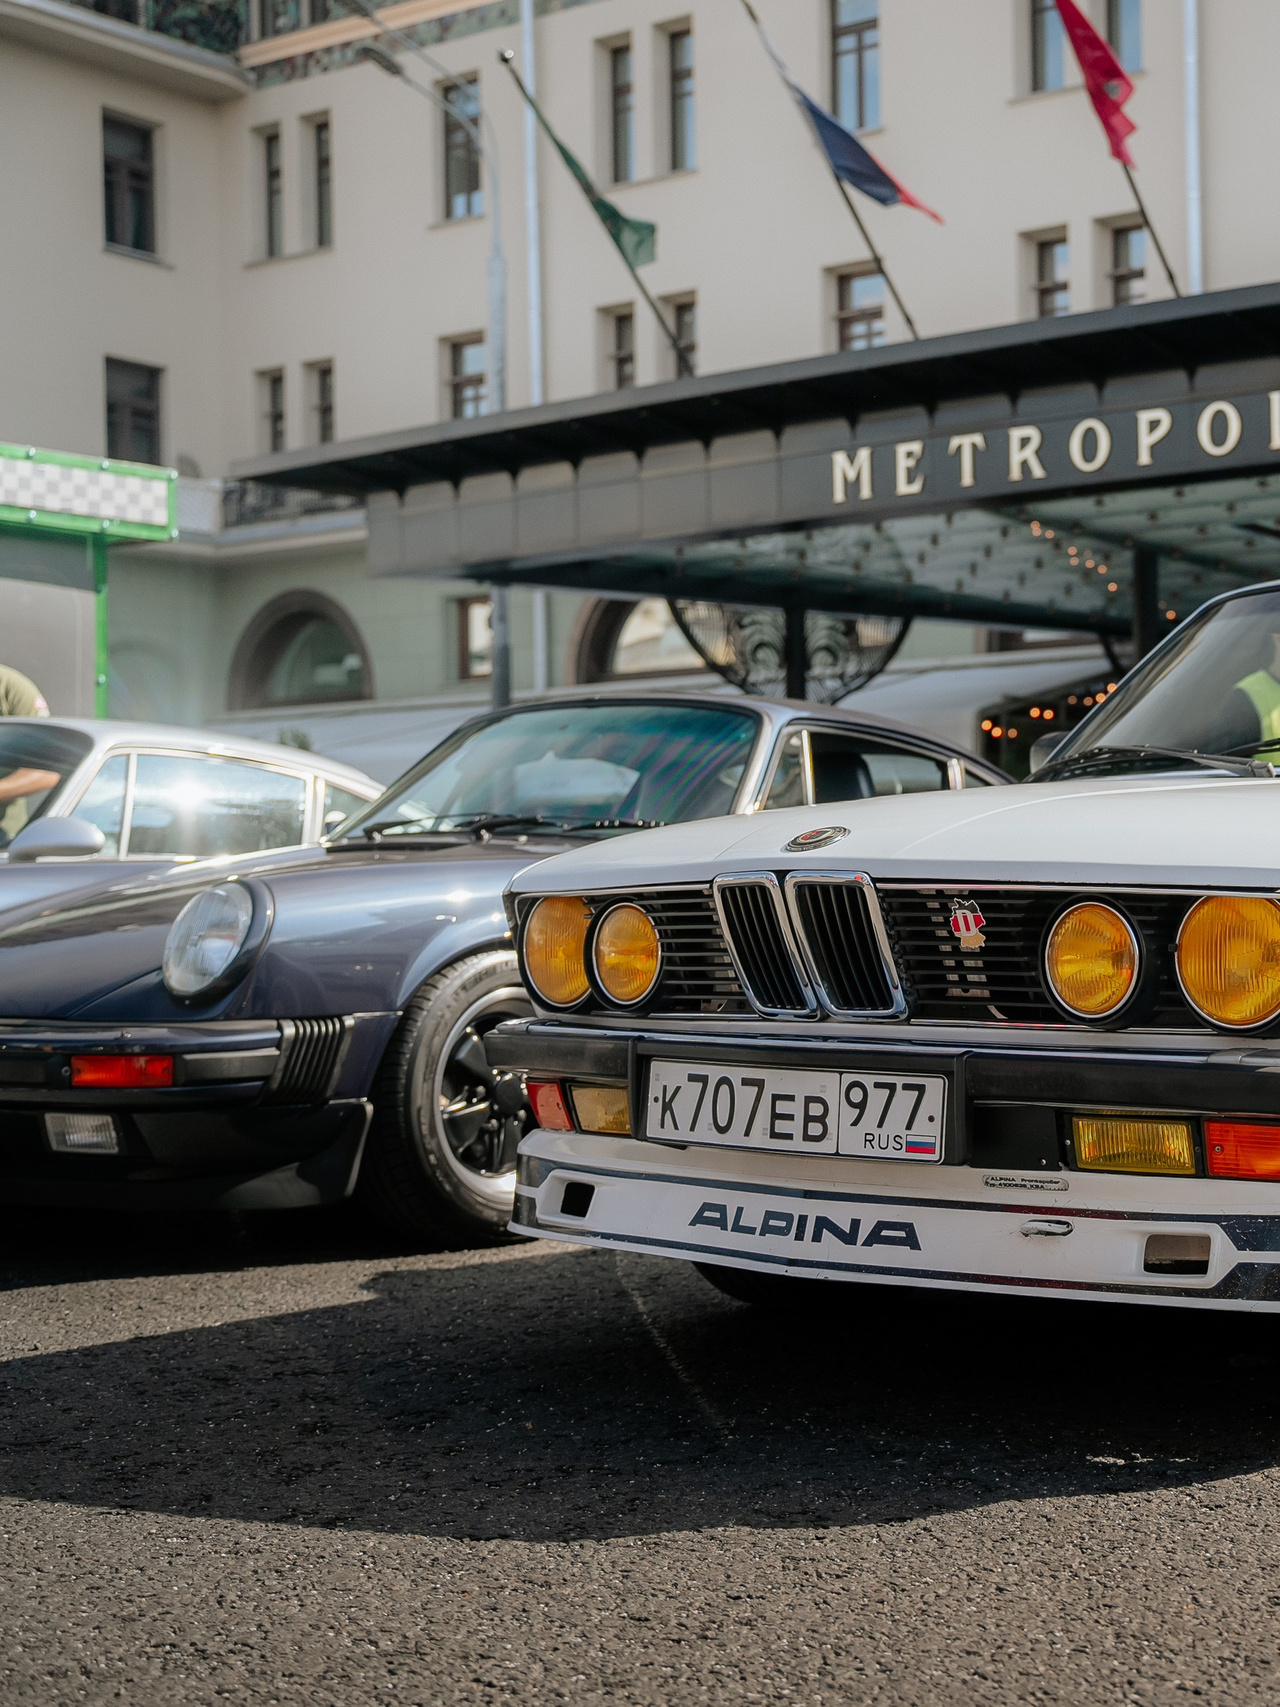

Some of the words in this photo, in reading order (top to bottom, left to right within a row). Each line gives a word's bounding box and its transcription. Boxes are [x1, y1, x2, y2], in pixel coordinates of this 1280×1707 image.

[956, 910, 976, 937] D
[660, 1073, 830, 1143] K707EB
[844, 1080, 926, 1131] 977
[863, 1132, 904, 1151] RUS
[688, 1201, 922, 1251] ALPINA
